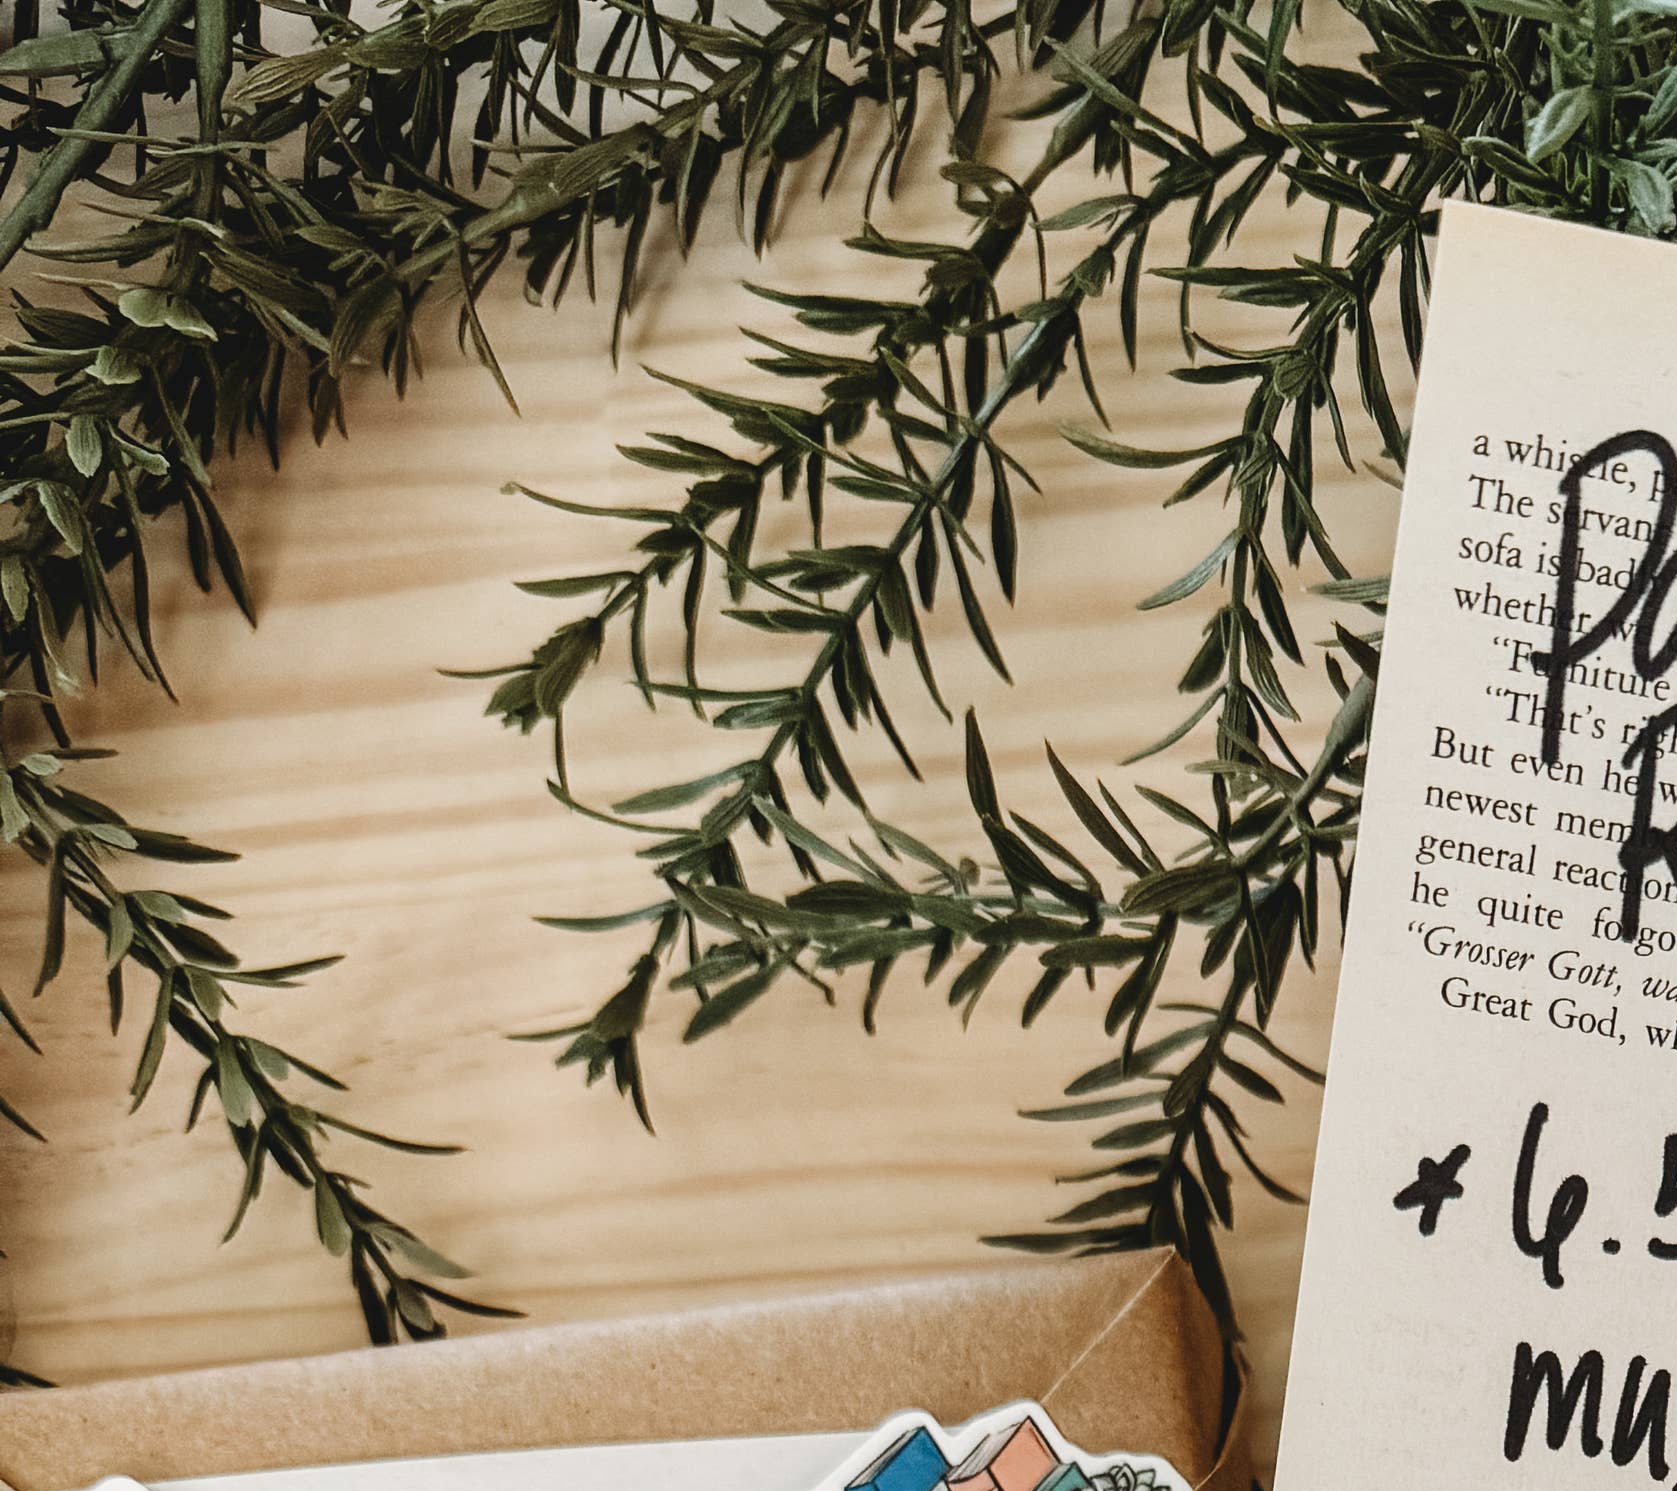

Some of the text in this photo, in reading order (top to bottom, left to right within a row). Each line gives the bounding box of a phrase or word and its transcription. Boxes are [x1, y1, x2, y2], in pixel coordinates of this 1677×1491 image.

[1473, 435, 1490, 457] a
[1504, 433, 1636, 493] whisle,
[1468, 474, 1534, 518] The
[1547, 499, 1671, 548] srvan
[1458, 532, 1523, 569] sofa
[1535, 541, 1568, 581] is
[1566, 545, 1667, 608] bad
[1454, 582, 1592, 638] whethr
[1493, 636, 1671, 702] “Funiture
[1431, 726, 1494, 768] But
[1510, 751, 1584, 786] even
[1601, 759, 1647, 799] he
[1425, 785, 1538, 826] newest
[1415, 835, 1537, 876] general
[1411, 871, 1449, 908] he
[1477, 893, 1564, 930] quite
[1408, 921, 1535, 972] “Grosser
[1548, 950, 1622, 997] Gott,
[1441, 976, 1533, 1022] Great
[1548, 997, 1626, 1046] God,
